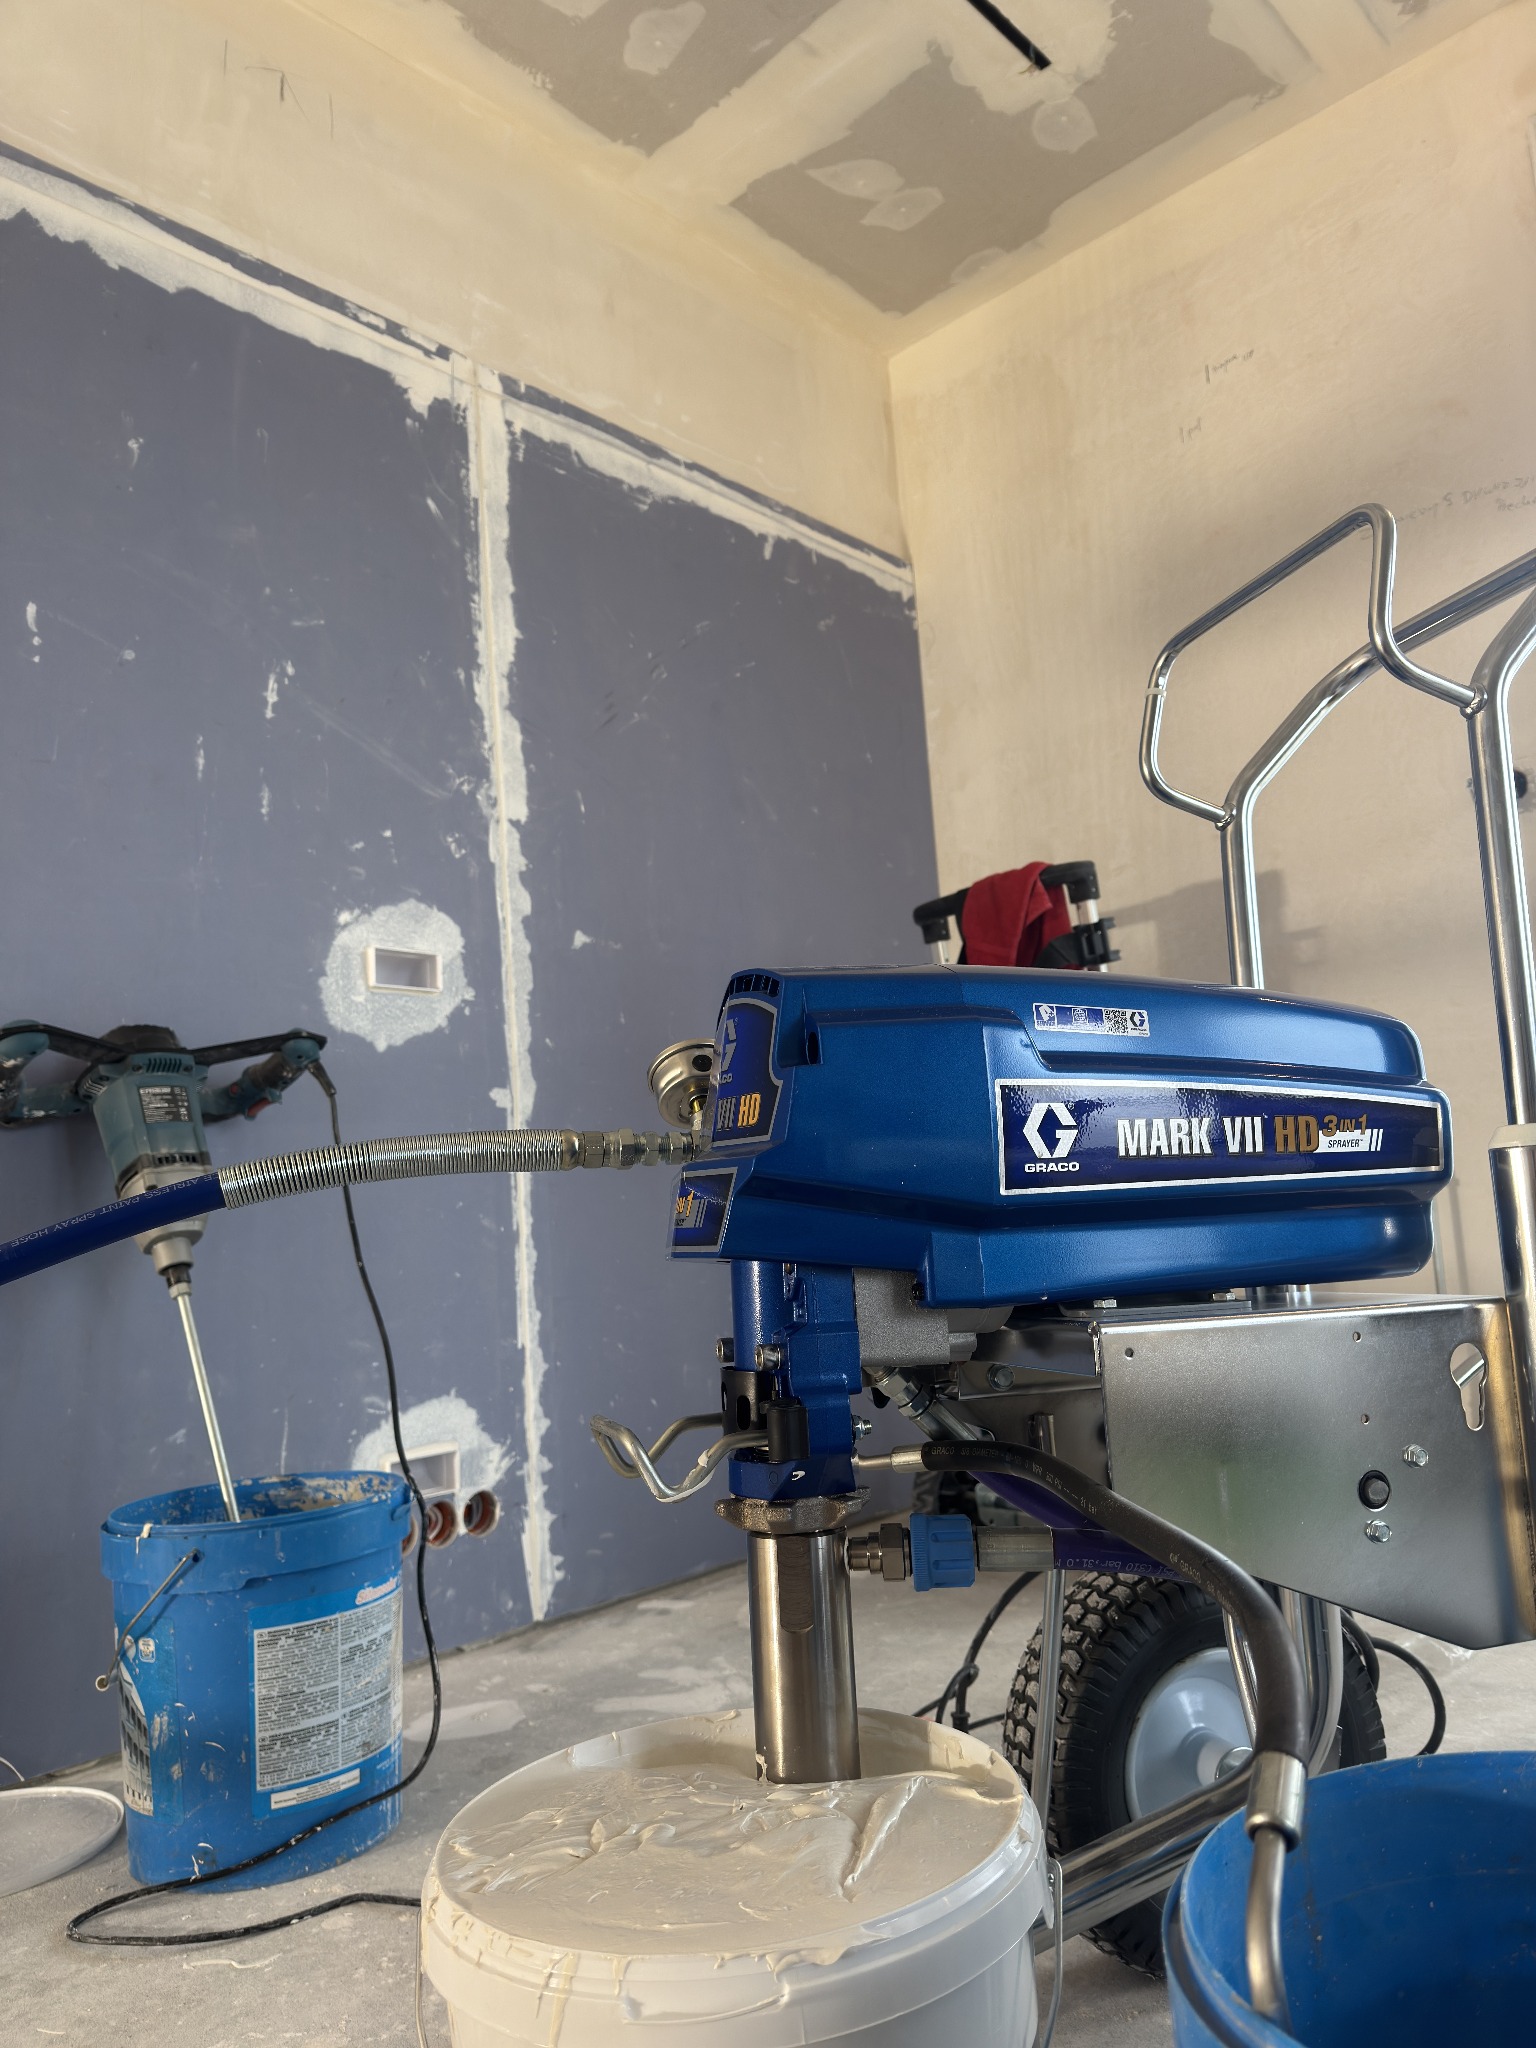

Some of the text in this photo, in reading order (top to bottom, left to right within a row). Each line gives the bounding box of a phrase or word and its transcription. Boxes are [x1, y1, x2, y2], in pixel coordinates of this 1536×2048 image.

[737, 1092, 761, 1129] HD
[1322, 1114, 1367, 1137] 3 IN 1
[1117, 1115, 1320, 1158] MARK VII HD
[1024, 1161, 1080, 1173] GRACO
[144, 1178, 199, 1199] AIRLESS
[100, 1197, 140, 1215] PAINT
[686, 1190, 694, 1217] 1
[53, 1211, 96, 1232] SPRAY
[10, 1228, 49, 1248] HOSE
[931, 1446, 955, 1455] GRACO
